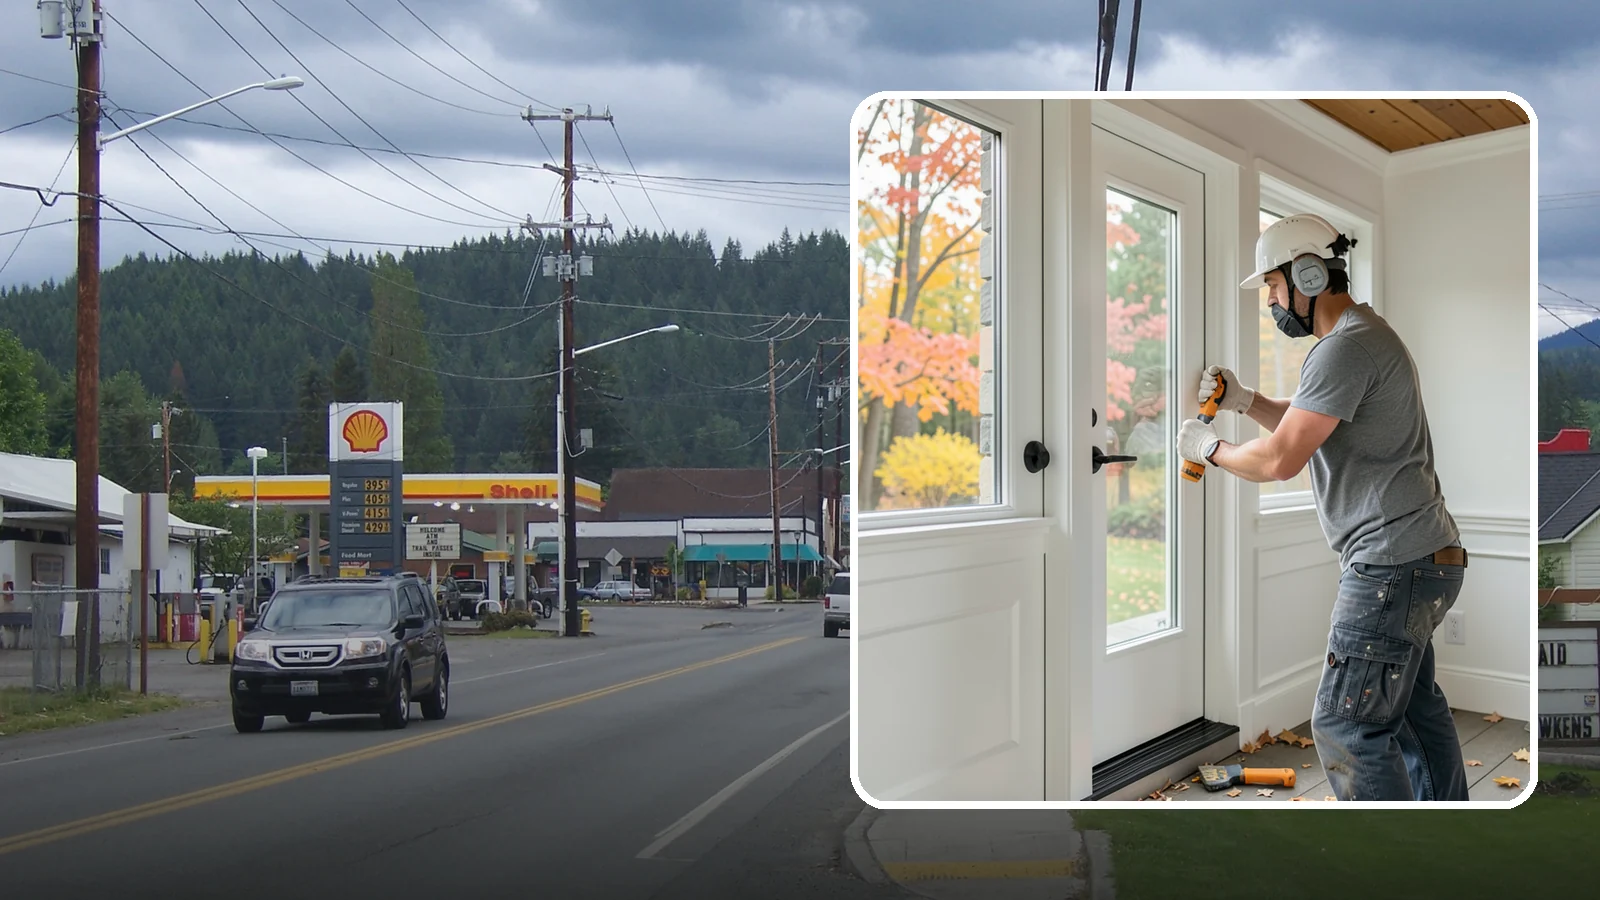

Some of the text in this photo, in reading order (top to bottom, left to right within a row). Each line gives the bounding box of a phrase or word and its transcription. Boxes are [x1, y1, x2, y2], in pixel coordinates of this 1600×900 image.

[366, 480, 383, 490] 395
[490, 484, 547, 499] Shell
[365, 494, 383, 504] 405
[365, 508, 383, 518] 415
[365, 522, 383, 532] 429
